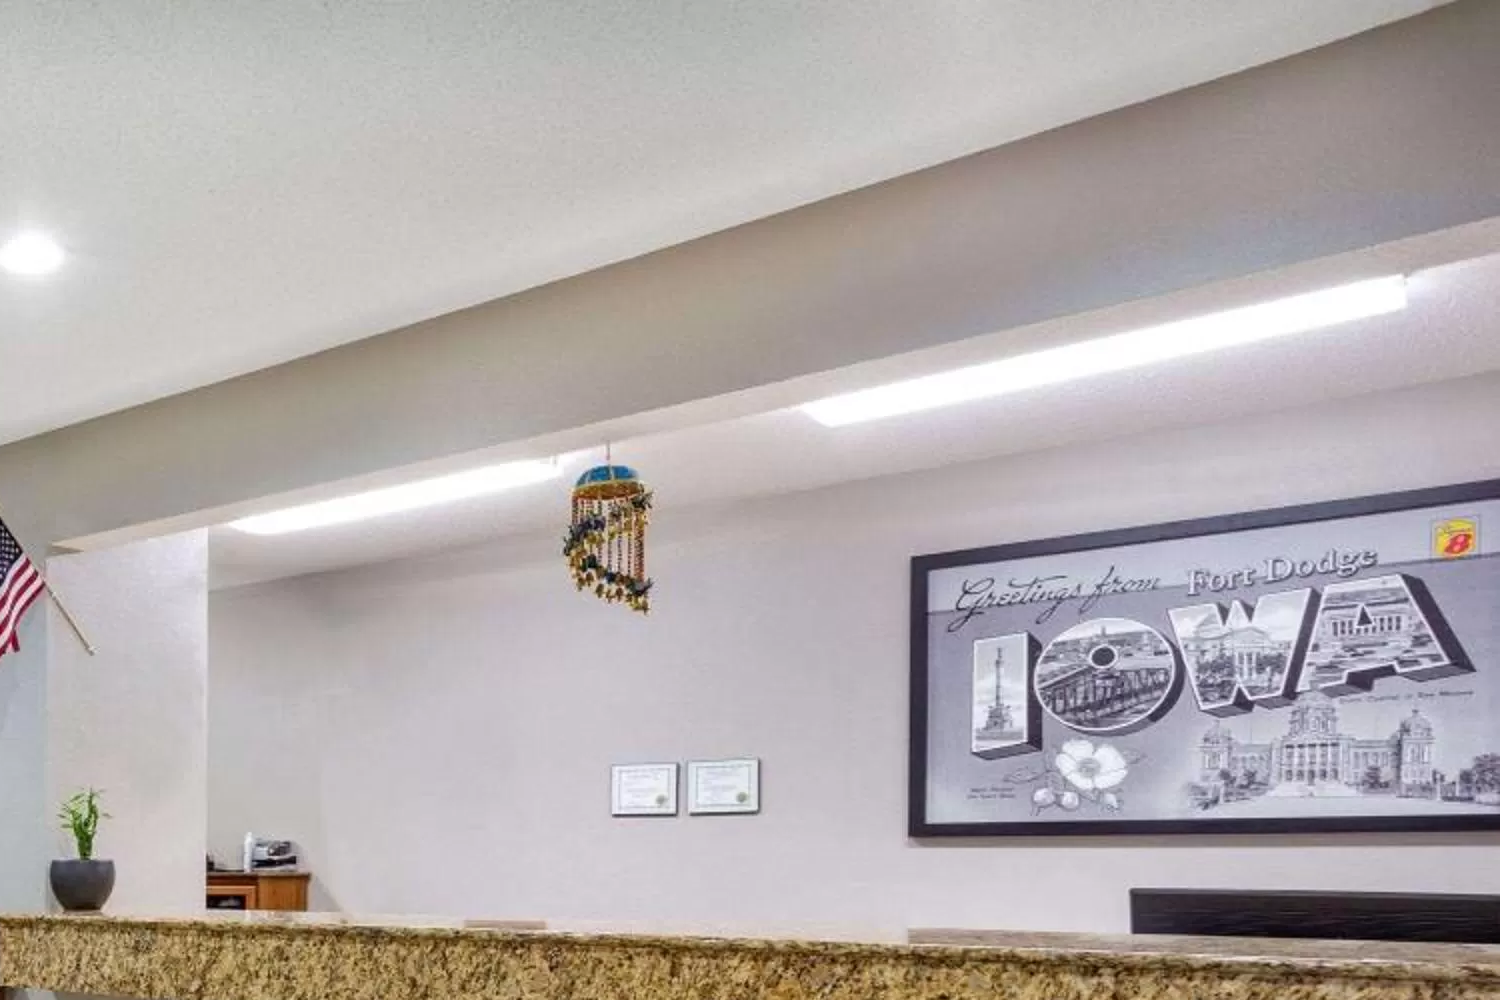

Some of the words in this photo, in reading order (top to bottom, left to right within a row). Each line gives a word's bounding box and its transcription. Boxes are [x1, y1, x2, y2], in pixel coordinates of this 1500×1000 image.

[948, 575, 1083, 632] Greetings
[1079, 565, 1161, 615] from
[1187, 568, 1257, 597] Fort
[1263, 547, 1379, 585] Dodge
[970, 573, 1476, 760] IOWA
